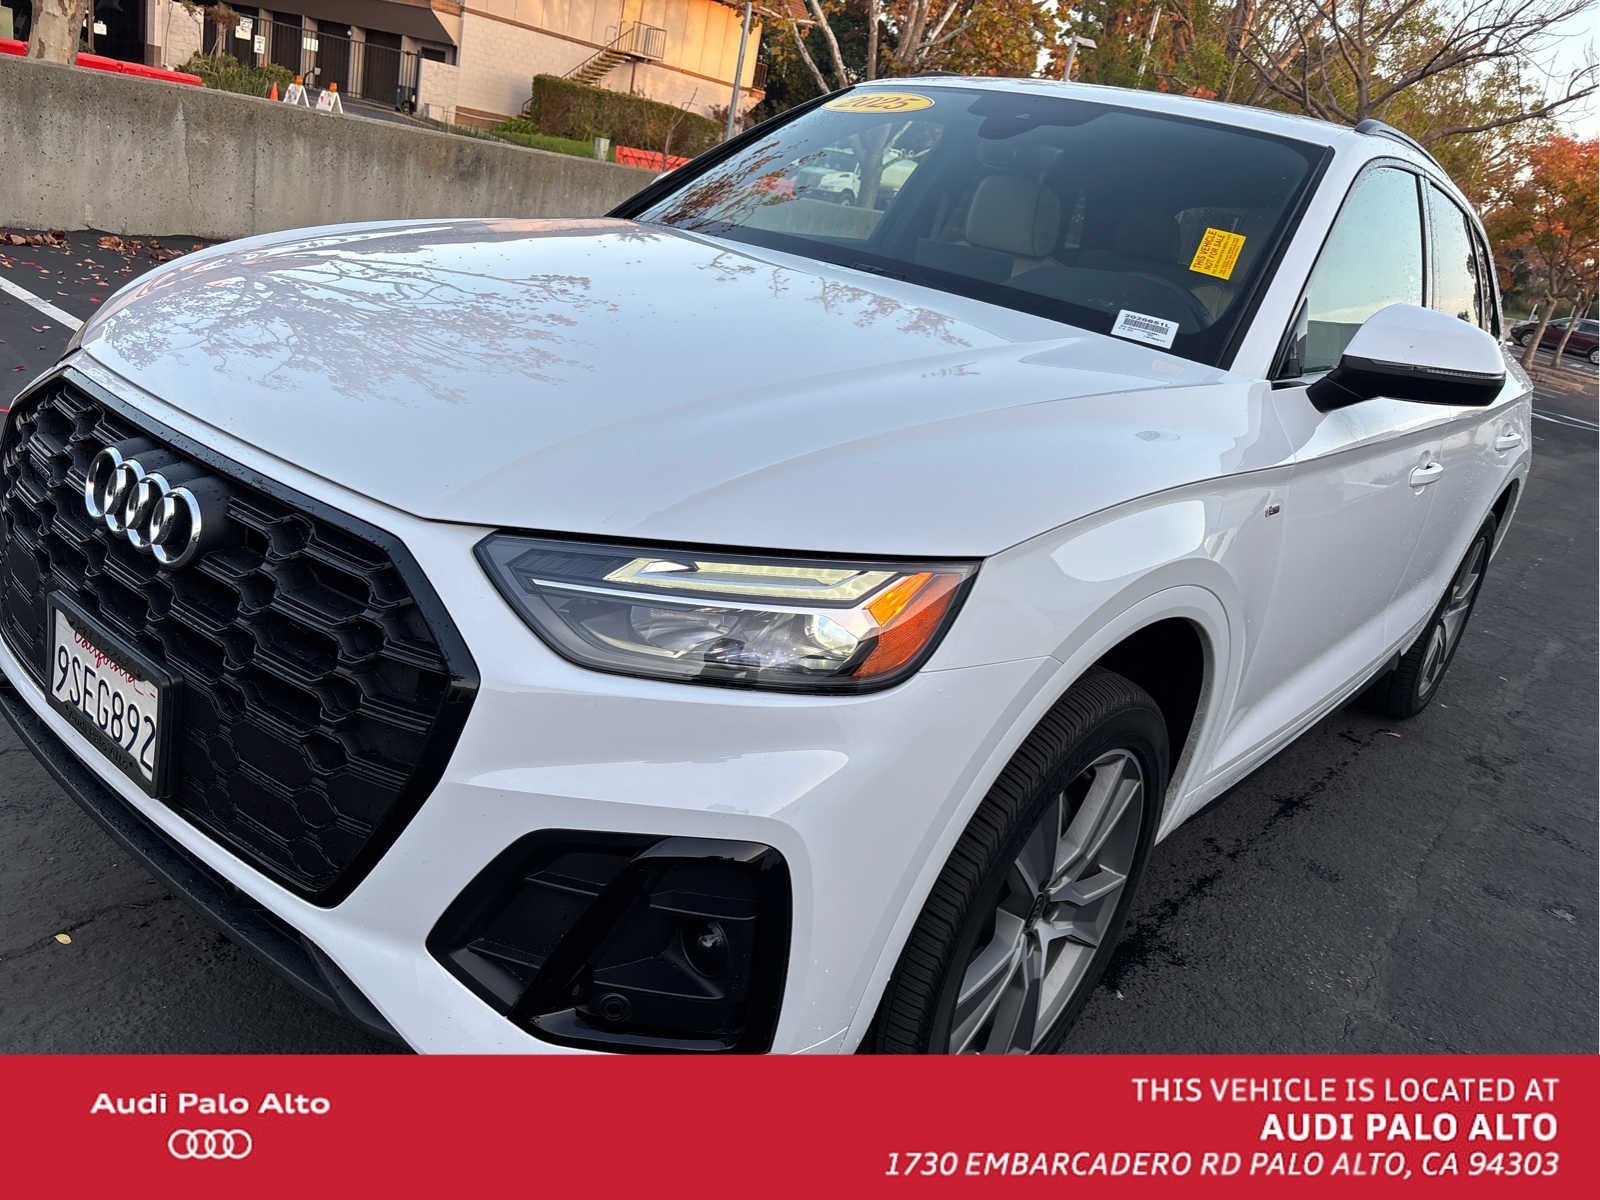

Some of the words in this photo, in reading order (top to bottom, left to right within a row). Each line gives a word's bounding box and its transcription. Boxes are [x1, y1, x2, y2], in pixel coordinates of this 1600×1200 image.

[832, 96, 923, 109] 2025
[1199, 230, 1217, 255] VEHICLE
[1212, 232, 1225, 249] SALE
[1193, 255, 1207, 269] THIS
[56, 645, 156, 773] 9SEG892
